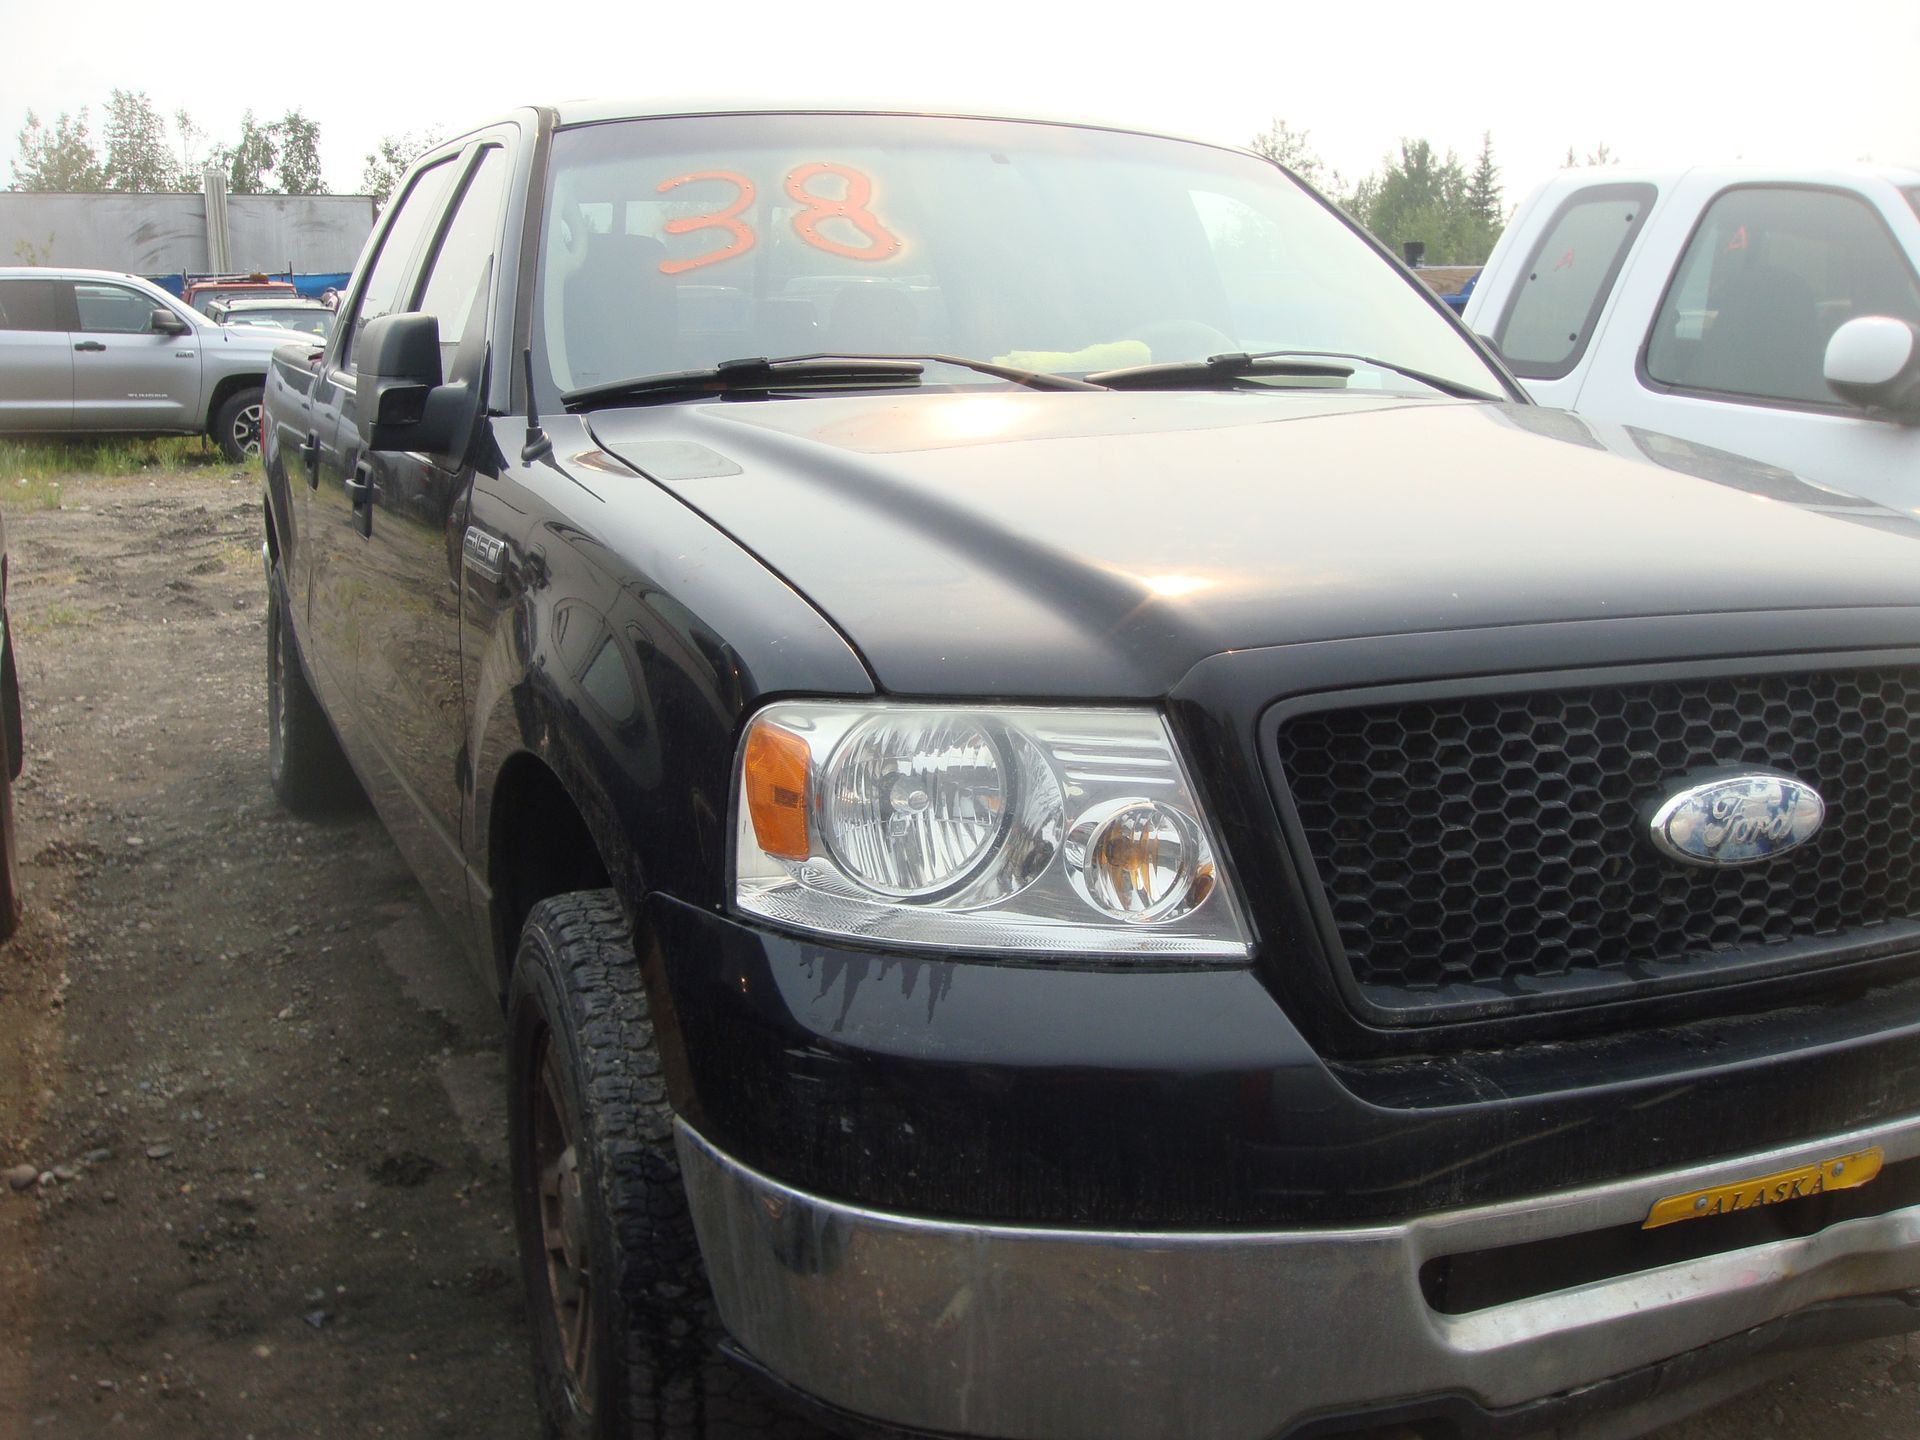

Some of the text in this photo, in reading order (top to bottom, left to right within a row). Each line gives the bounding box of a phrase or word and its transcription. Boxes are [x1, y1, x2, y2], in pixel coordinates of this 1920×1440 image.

[656, 163, 902, 275] 38
[1703, 789, 1799, 848] Ford
[1707, 1170, 1825, 1215] ALASKA
